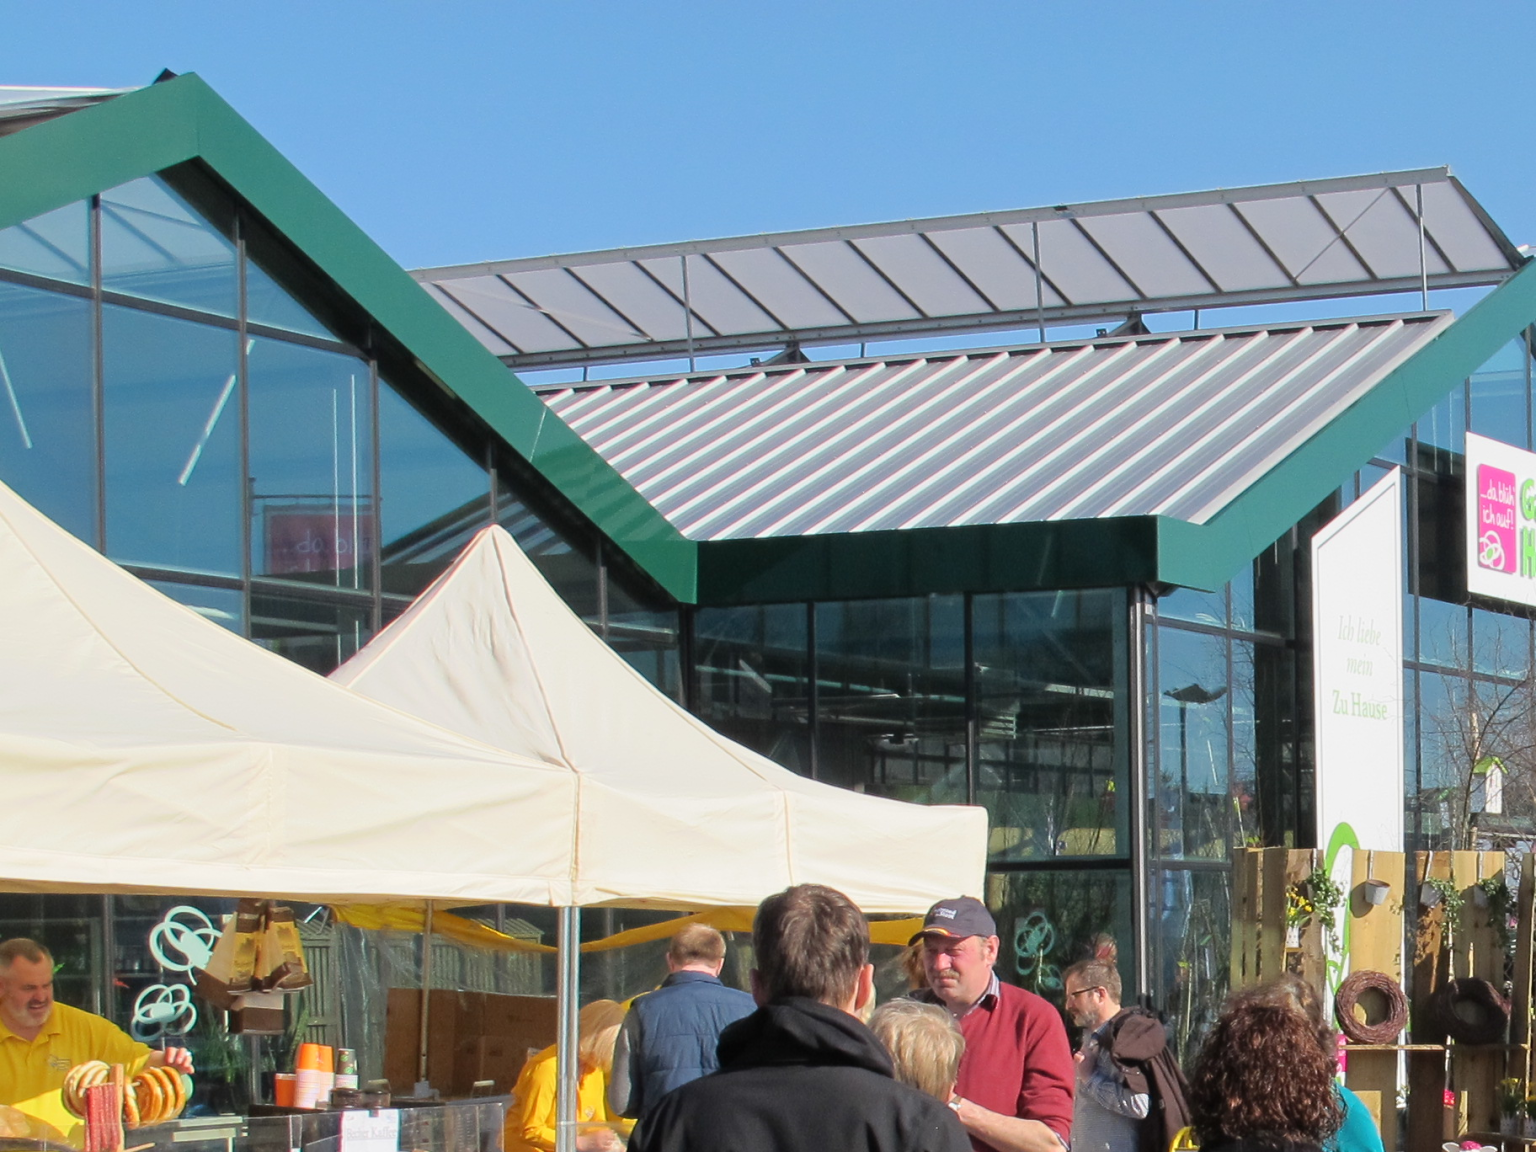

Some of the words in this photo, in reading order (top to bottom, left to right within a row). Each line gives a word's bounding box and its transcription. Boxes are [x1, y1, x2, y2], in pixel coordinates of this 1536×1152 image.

[1483, 505, 1495, 524] ich
[1496, 510, 1514, 531] auf!
[1338, 614, 1354, 641] Ich
[1357, 617, 1381, 646] liebe
[1346, 653, 1373, 677] mein
[1332, 689, 1349, 715] Zu
[1351, 692, 1388, 720] Hause
